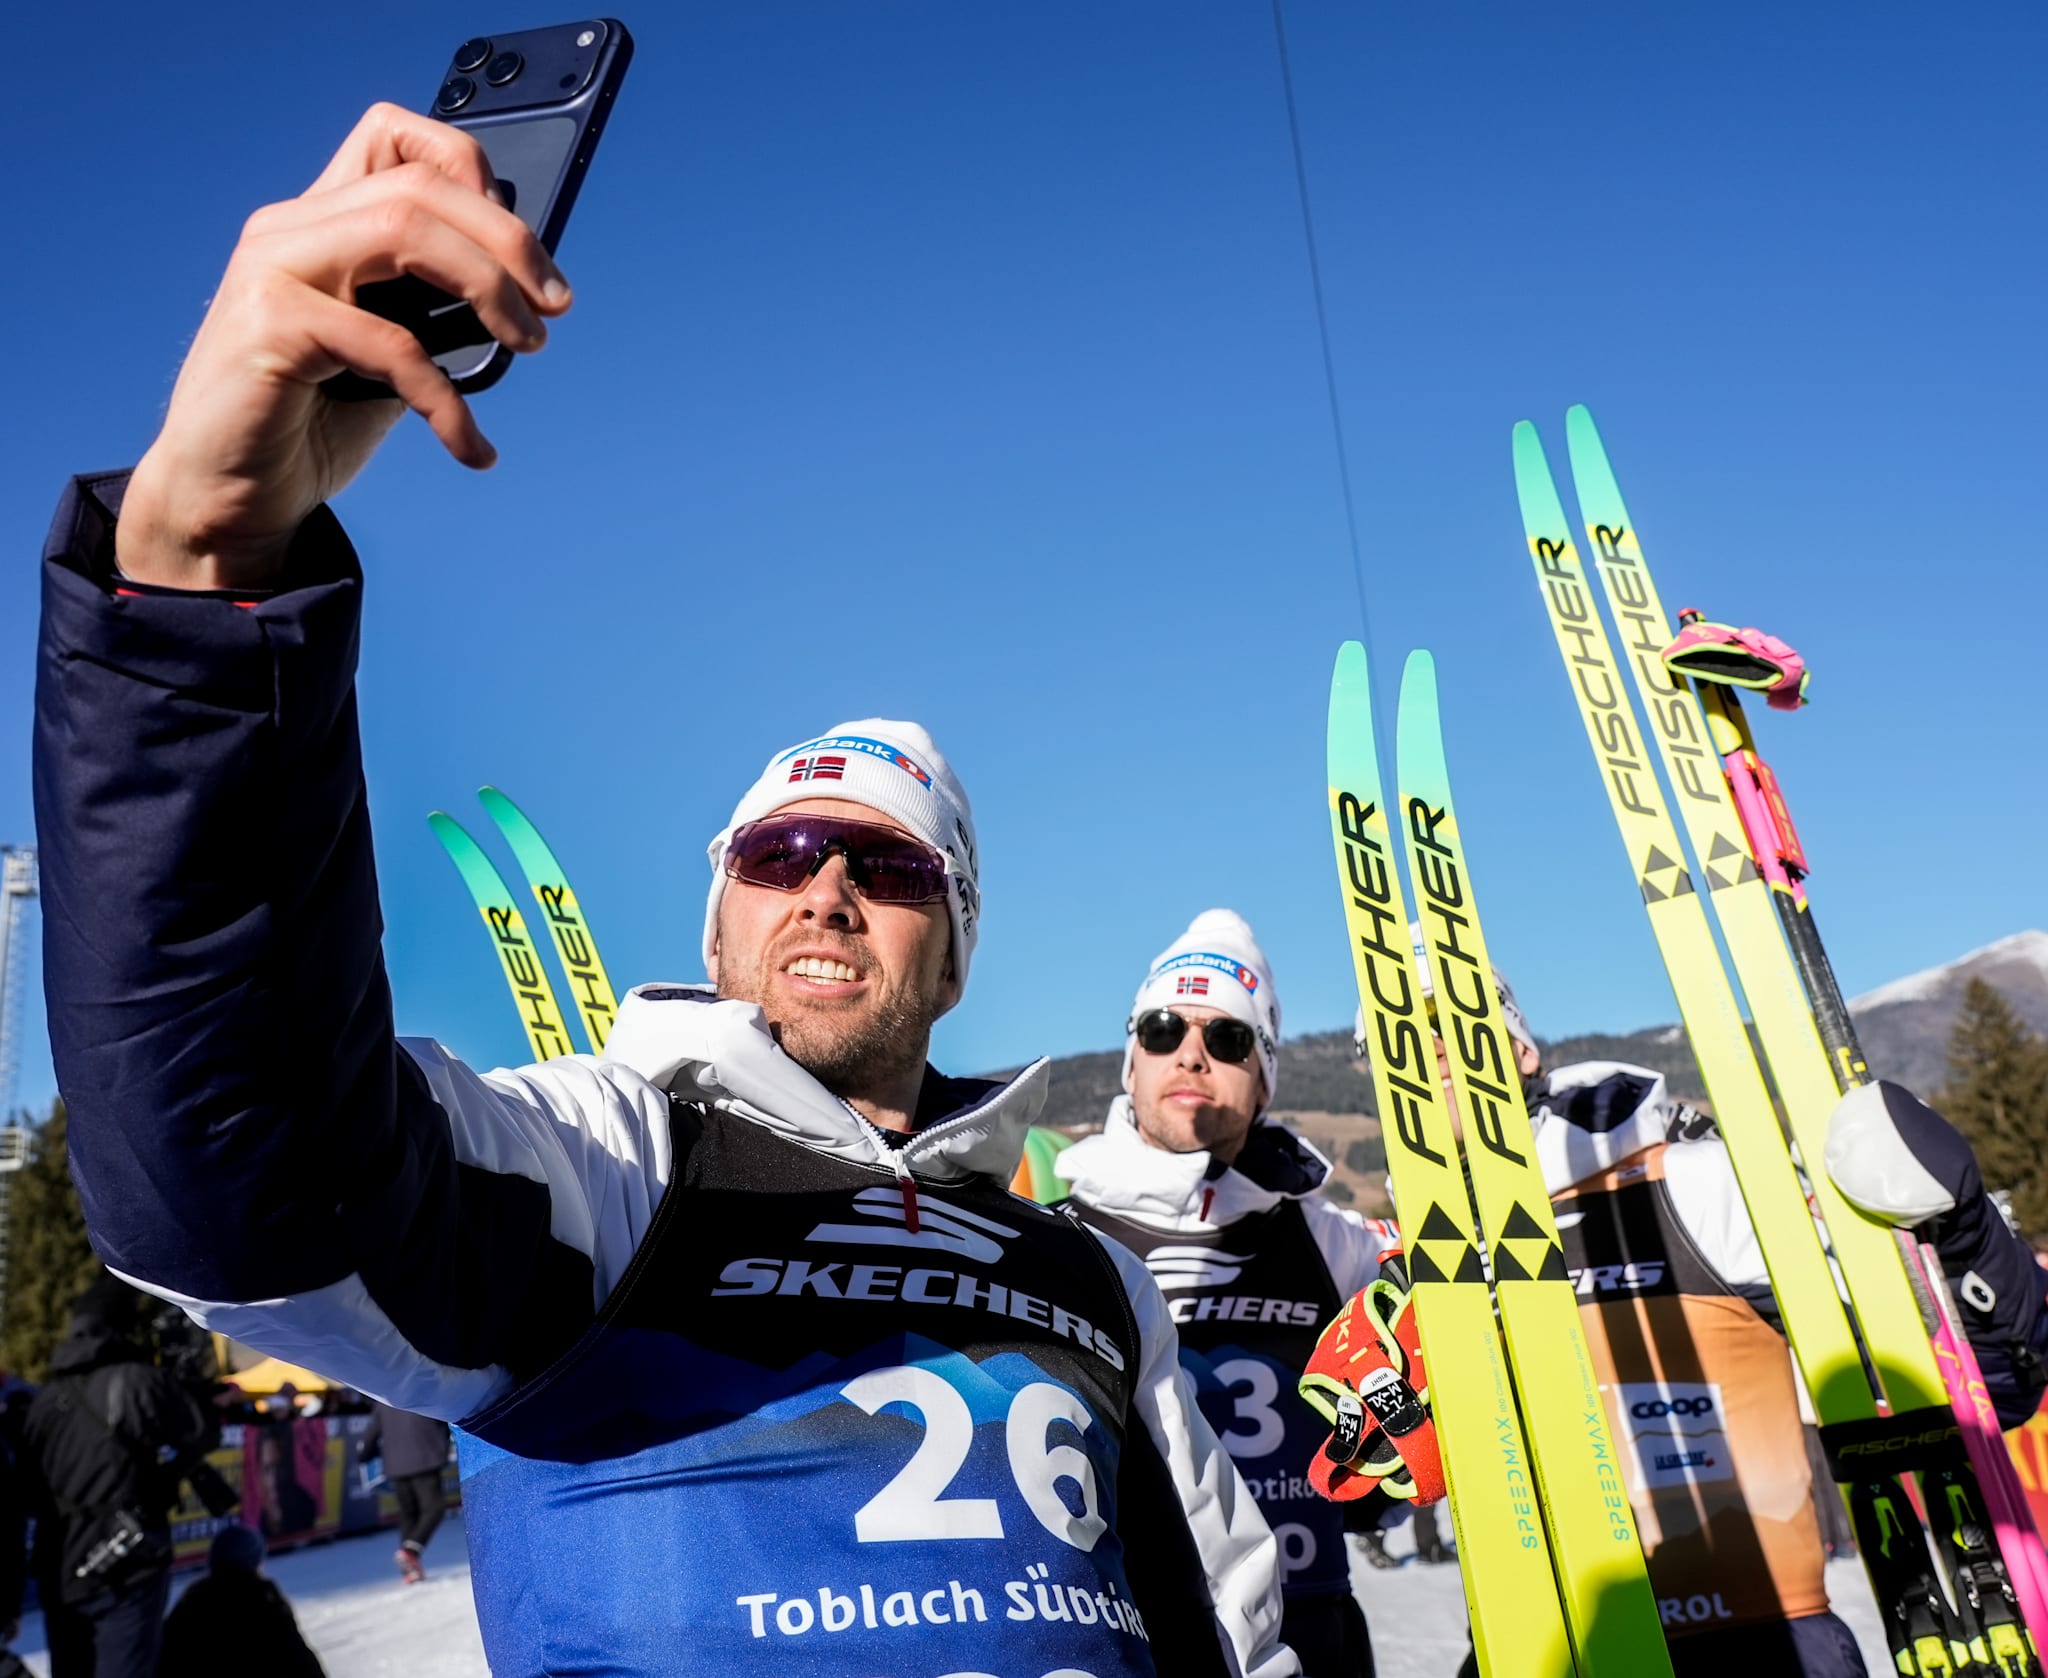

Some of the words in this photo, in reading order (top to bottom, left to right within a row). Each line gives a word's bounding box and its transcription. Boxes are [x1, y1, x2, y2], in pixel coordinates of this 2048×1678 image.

[1537, 536, 1657, 816] FISCHER
[1595, 523, 1720, 803] FISCHER
[1338, 791, 1447, 1169] FISCHER
[1408, 797, 1527, 1169] FISCHER
[710, 1257, 1125, 1372] SKECHERS
[1168, 1296, 1319, 1326] CHERS
[1180, 1357, 1286, 1459] 3
[1371, 1372, 1389, 1387] RIGHT
[1630, 1396, 1713, 1419] coop
[839, 1365, 1108, 1553] 26
[1495, 1417, 1538, 1549] SPEEDMAX
[1584, 1412, 1630, 1541] SPEEDMAX
[737, 1580, 987, 1638] Toblach
